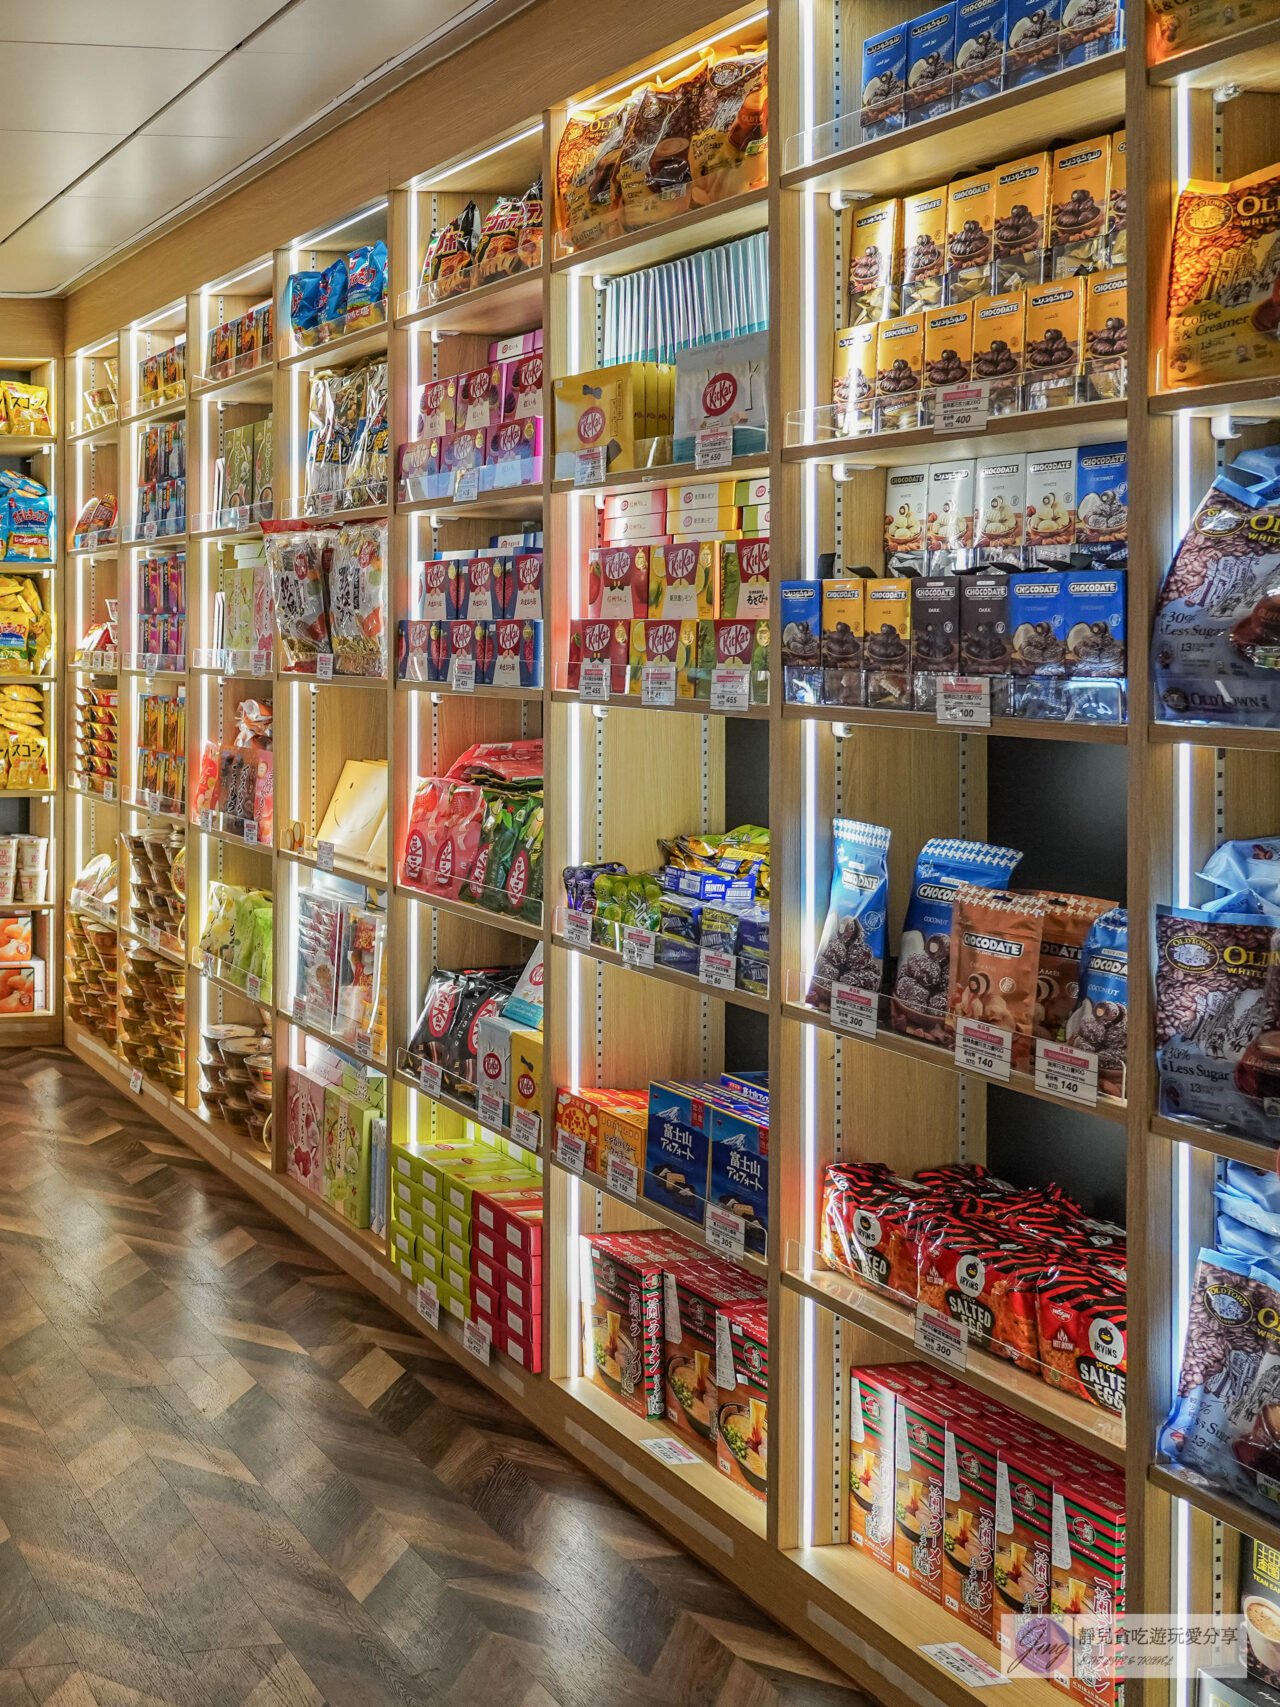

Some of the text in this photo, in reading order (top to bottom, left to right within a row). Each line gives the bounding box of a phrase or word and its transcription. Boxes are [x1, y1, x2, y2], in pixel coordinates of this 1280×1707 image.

[952, 184, 990, 201] CHOCODATE
[979, 303, 1019, 319] CHOCODATE
[1182, 311, 1221, 327] Coffee
[1195, 314, 1250, 338] Creamer
[522, 361, 543, 386] KitKat
[470, 374, 490, 398] KitKat
[706, 383, 733, 410] KitKat
[955, 415, 971, 424] 400
[499, 426, 521, 451] KitKat
[981, 464, 1019, 476] CHOCODATE
[1030, 461, 1072, 474] CHOCODATE
[1081, 453, 1127, 467] CHOCODATE
[891, 473, 924, 485] CHOCODATE
[604, 553, 631, 579] KitKat
[668, 550, 695, 578] KitKat
[743, 545, 770, 575] KitKa
[471, 564, 490, 586] KitKat
[520, 560, 541, 584] KitKat
[825, 589, 860, 600] CHOCODATE
[870, 590, 906, 600] CHOCODATE
[915, 587, 955, 598] CHOCODATE
[965, 586, 1008, 598] CHOCODATE
[1015, 583, 1060, 595] CHOCODATE
[1069, 582, 1117, 595] CHOCODATE
[500, 625, 520, 649] KitKat
[586, 625, 611, 651] KitKat
[648, 626, 675, 654] KitKat
[721, 626, 751, 655] KitKat
[11, 743, 46, 758] スコーン
[407, 837, 423, 878] KitKat
[704, 883, 726, 893] MINTIA
[1088, 983, 1119, 996] COCONUT
[431, 991, 452, 1030] KitKat
[850, 1016, 863, 1027] 300
[978, 1056, 993, 1068] 140
[1168, 1060, 1231, 1083] Less Sugar
[1061, 1081, 1078, 1092] 140
[663, 1123, 693, 1147] 富士山
[660, 1137, 695, 1161] アルフォート
[729, 1151, 761, 1177] 富士山
[726, 1165, 764, 1191] アルフォート
[949, 1296, 992, 1329] SALTED
[936, 1343, 950, 1356] 300
[1095, 1360, 1116, 1373] SPICY
[1079, 1363, 1126, 1393] SALTE
